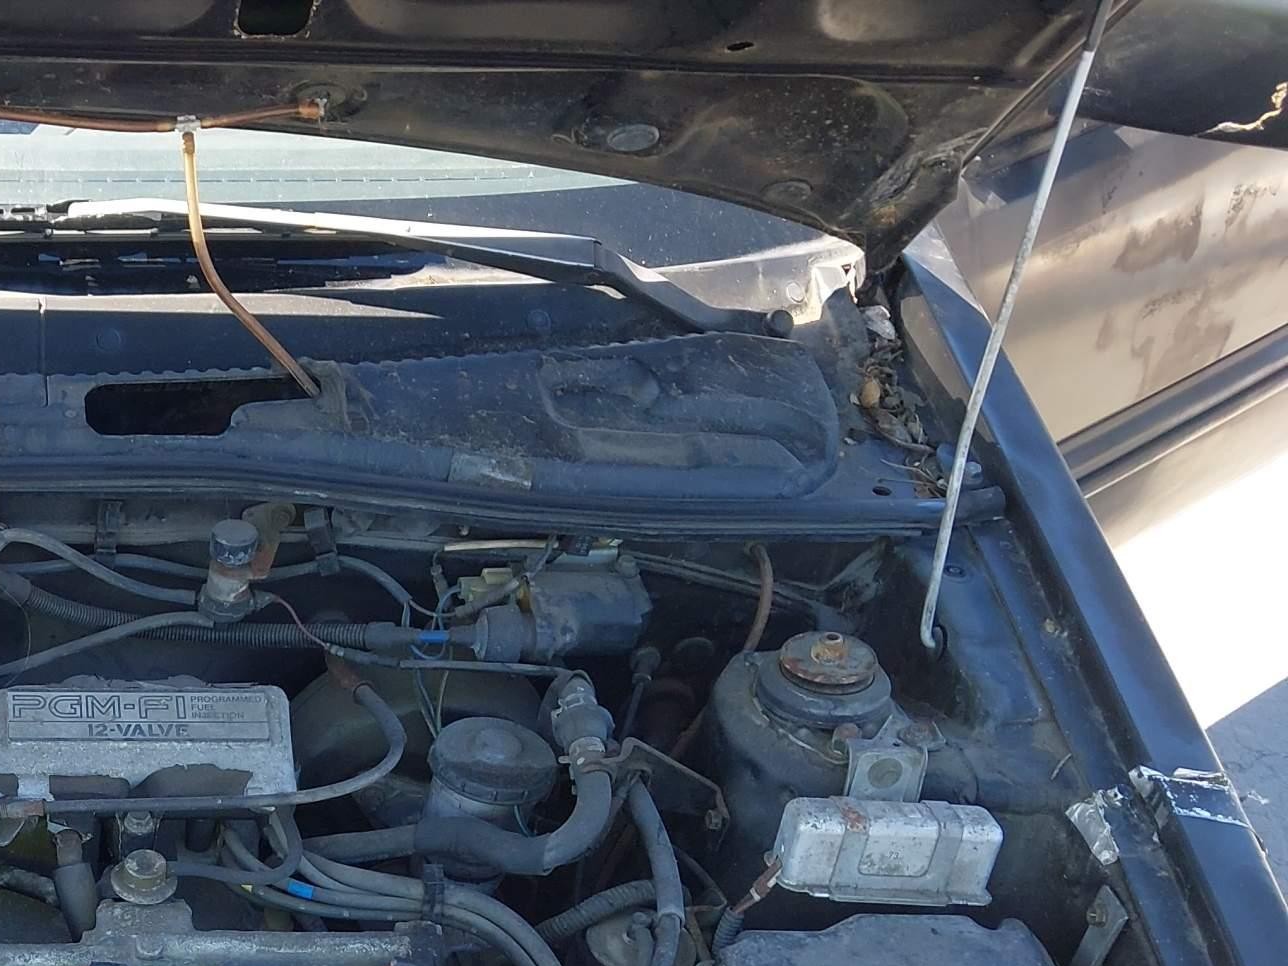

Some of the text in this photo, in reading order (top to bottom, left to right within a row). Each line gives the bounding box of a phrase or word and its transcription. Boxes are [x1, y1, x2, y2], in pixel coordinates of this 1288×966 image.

[190, 695, 263, 704] PROGRAMMED
[12, 694, 187, 720] PGM-FI
[190, 703, 216, 712] FUEL
[190, 711, 246, 720] INJECTION
[87, 723, 190, 738] 12-VALVE
